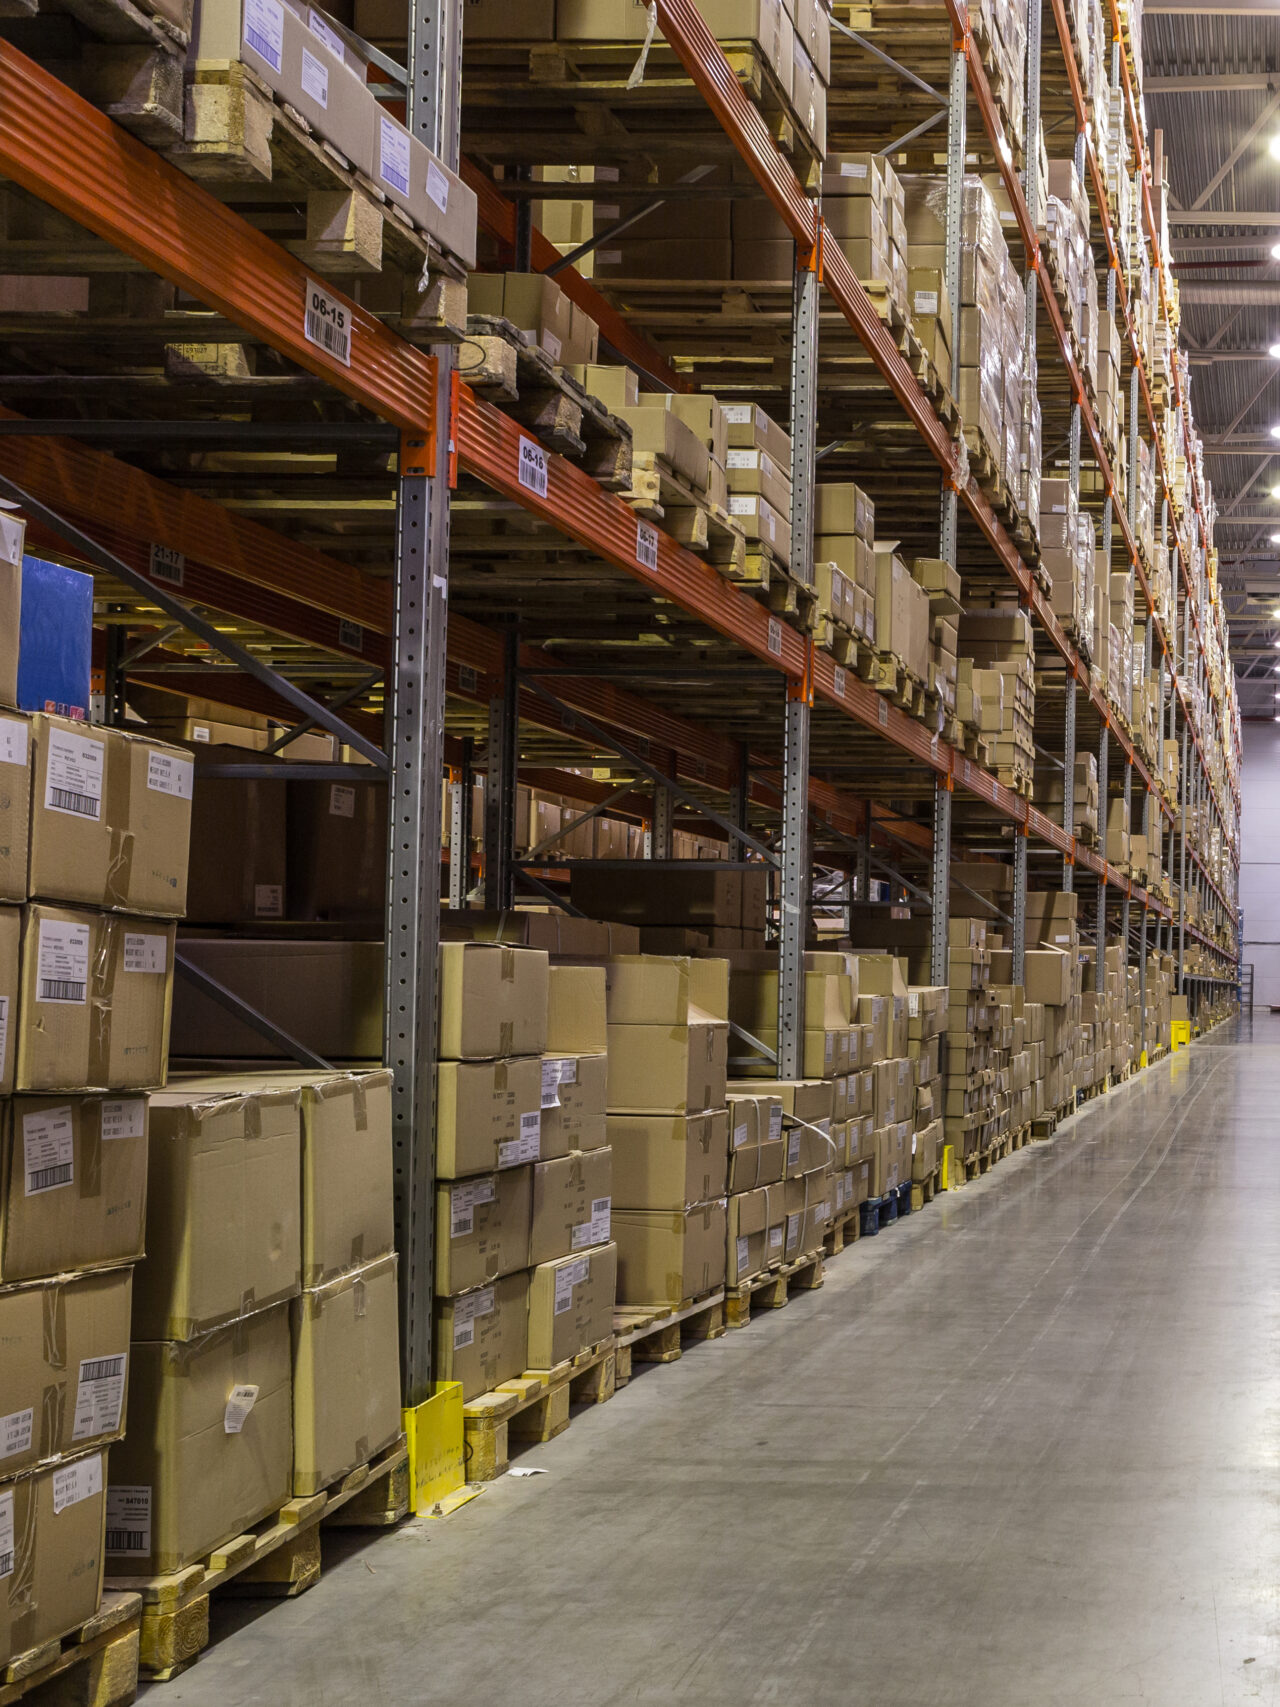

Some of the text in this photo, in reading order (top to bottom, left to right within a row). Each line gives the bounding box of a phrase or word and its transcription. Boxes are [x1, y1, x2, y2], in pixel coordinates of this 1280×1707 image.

[312, 293, 345, 328] 06-15
[523, 445, 543, 470] 06-16
[154, 544, 180, 565] 21-17
